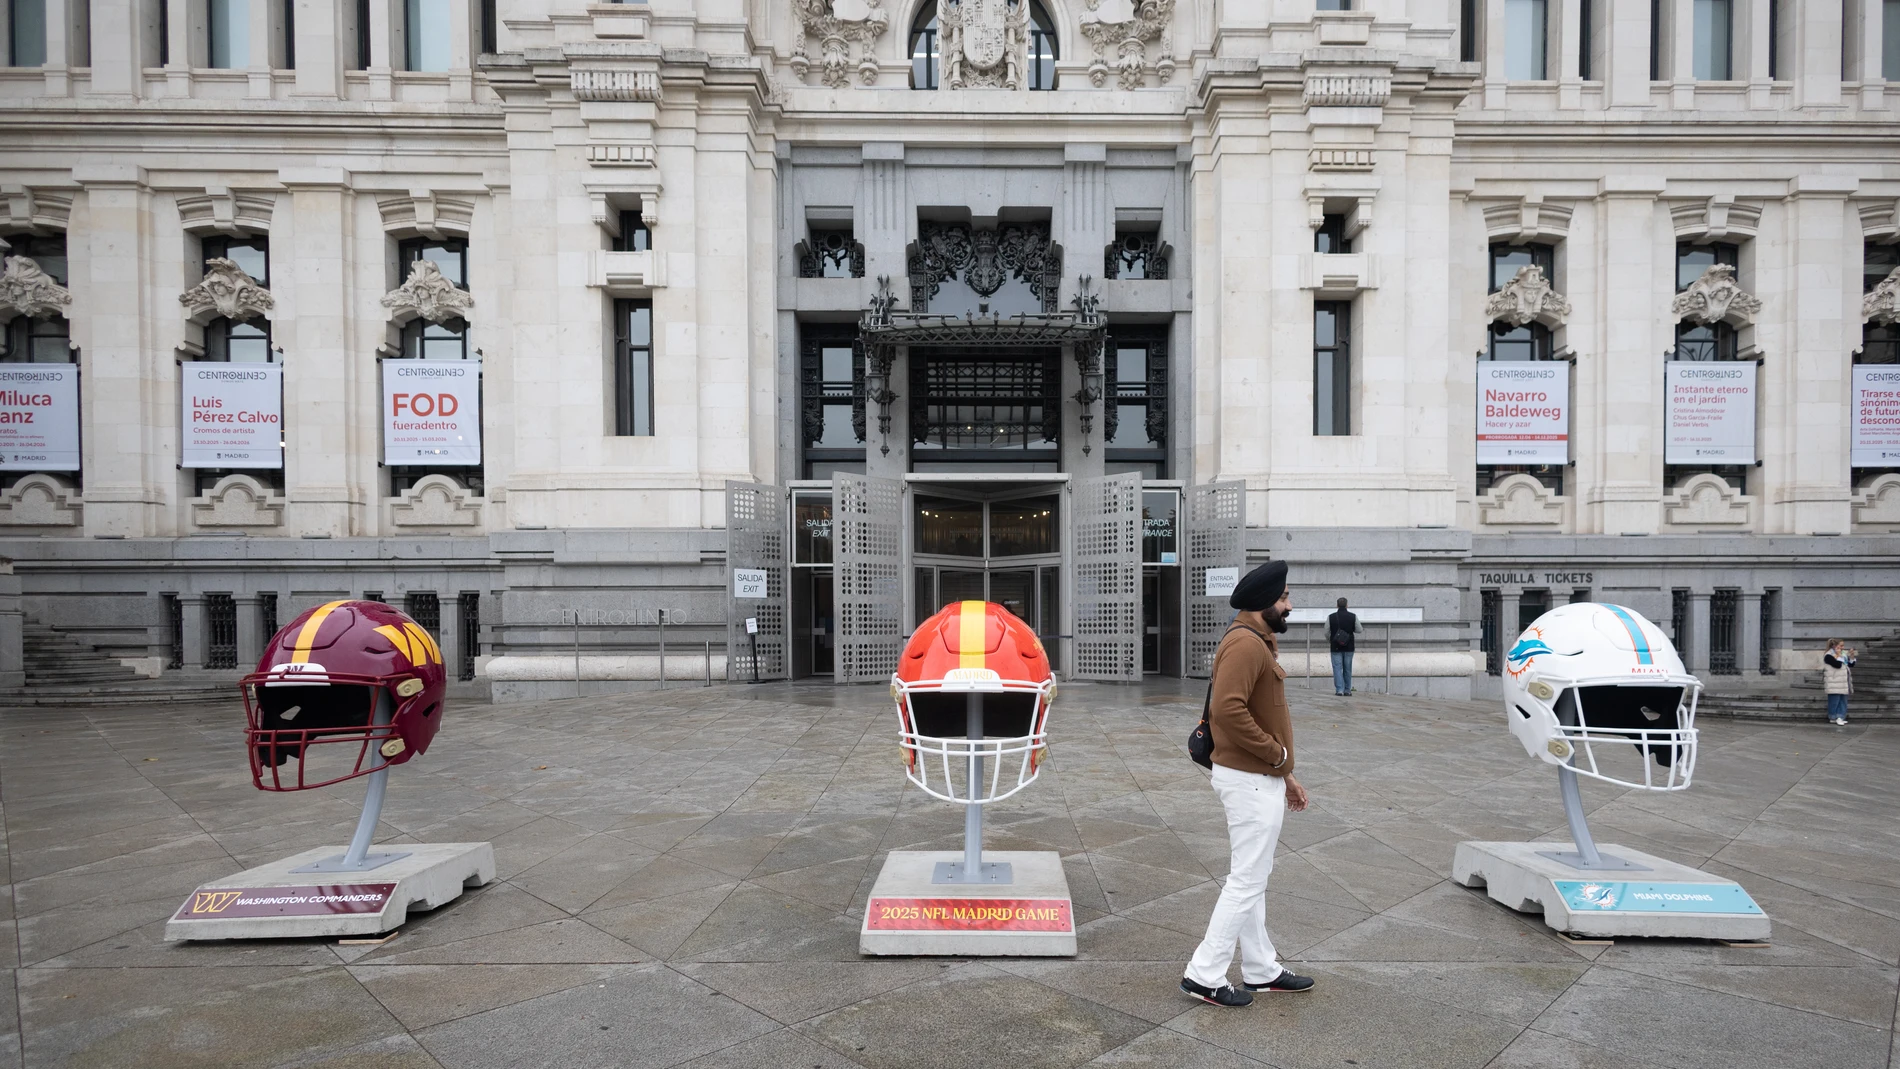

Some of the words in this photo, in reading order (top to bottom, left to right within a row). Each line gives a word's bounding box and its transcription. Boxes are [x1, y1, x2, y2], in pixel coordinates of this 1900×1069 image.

[1674, 385, 1714, 394] Instante
[1717, 386, 1748, 394] eterno
[1860, 390, 1894, 398] Tirarse
[1486, 389, 1547, 402] Navarro
[1688, 395, 1696, 404] el
[1698, 395, 1726, 405] jardín
[193, 396, 222, 408] Luis
[392, 393, 458, 417] FOD
[1860, 398, 1900, 406] sinónim
[193, 410, 234, 423] Pérez
[238, 411, 278, 423] Calvo
[1486, 404, 1560, 420] Baldeweg
[1860, 408, 1872, 416] de
[1876, 408, 1900, 416] futur
[0, 411, 34, 424] anz
[1860, 416, 1900, 424] descono
[393, 420, 457, 430] fueradentro
[1486, 420, 1507, 428] Hacer
[1142, 519, 1170, 527] TRADA
[812, 530, 830, 538] EXIT
[738, 574, 764, 582] SALIDA
[1480, 573, 1535, 584] TAQUILLA
[1544, 573, 1593, 583] TICKETS
[953, 670, 992, 680] MADRID
[236, 894, 308, 906] WASHINGTON
[308, 894, 383, 904] COMMANDERS
[1664, 893, 1714, 902] DOLPHINS
[881, 907, 919, 920] 2025
[922, 908, 950, 920] NFL
[953, 908, 1012, 921] MADRID
[1016, 908, 1059, 921] GAME
